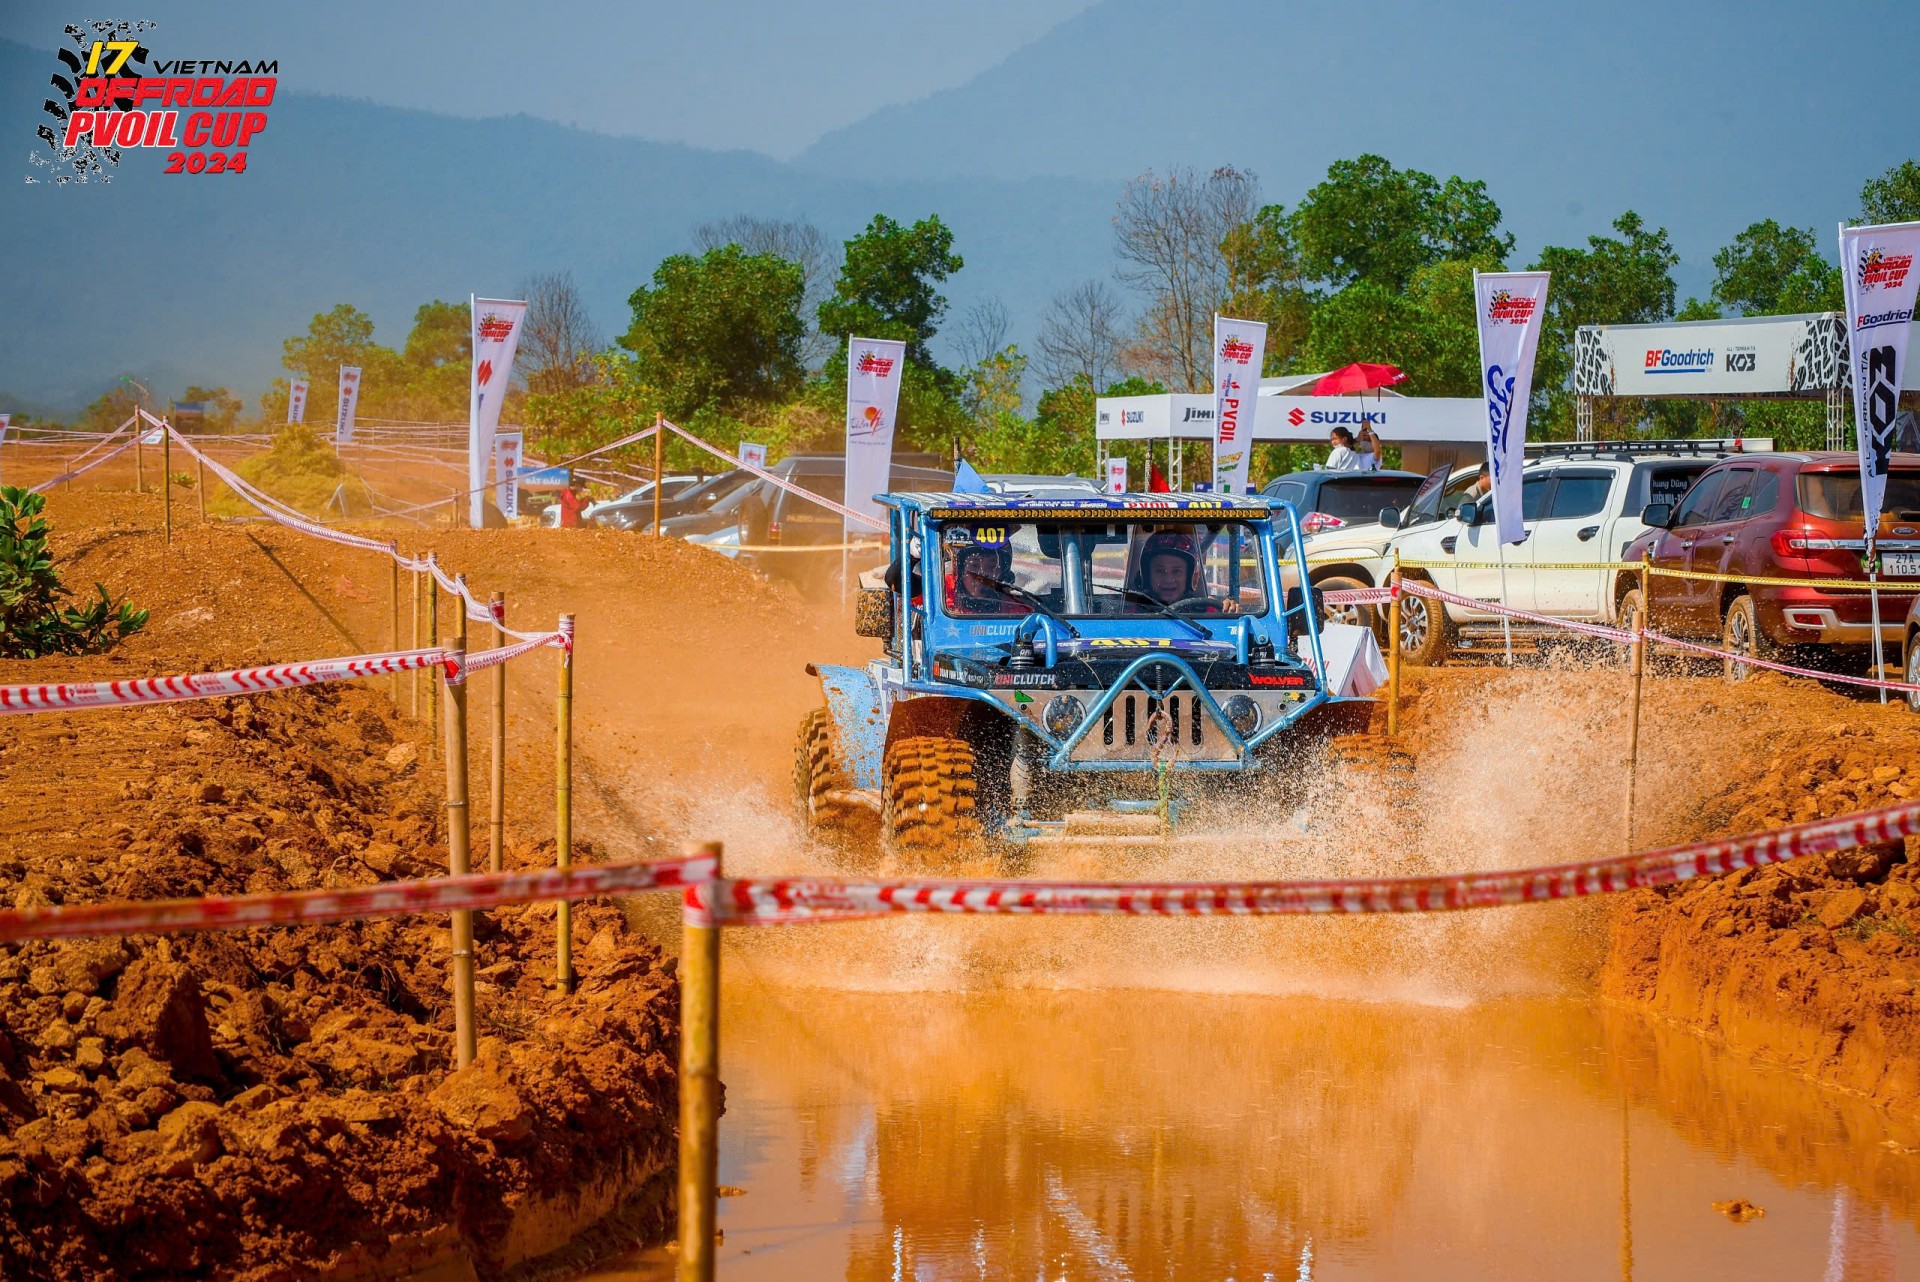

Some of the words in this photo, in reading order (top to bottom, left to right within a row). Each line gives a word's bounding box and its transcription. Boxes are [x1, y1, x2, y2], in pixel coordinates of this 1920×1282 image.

[1865, 260, 1911, 273] OFFROAD
[1863, 273, 1887, 285] PVOIL
[1889, 269, 1908, 281] CUP
[1884, 281, 1902, 289] 2024
[1514, 310, 1533, 318] CUP
[1645, 348, 1714, 367] BFGoodrich
[1861, 350, 1869, 372] T/A
[1220, 399, 1239, 444] PVOIL
[1310, 411, 1386, 424] SUZUKI
[506, 470, 514, 513] SUZUKI
[976, 528, 1005, 543] 407
[1895, 554, 1914, 564] 27A
[1089, 639, 1173, 648] 407
[995, 674, 1055, 686] UNICLUTCH
[1248, 673, 1304, 685] WOLVER
